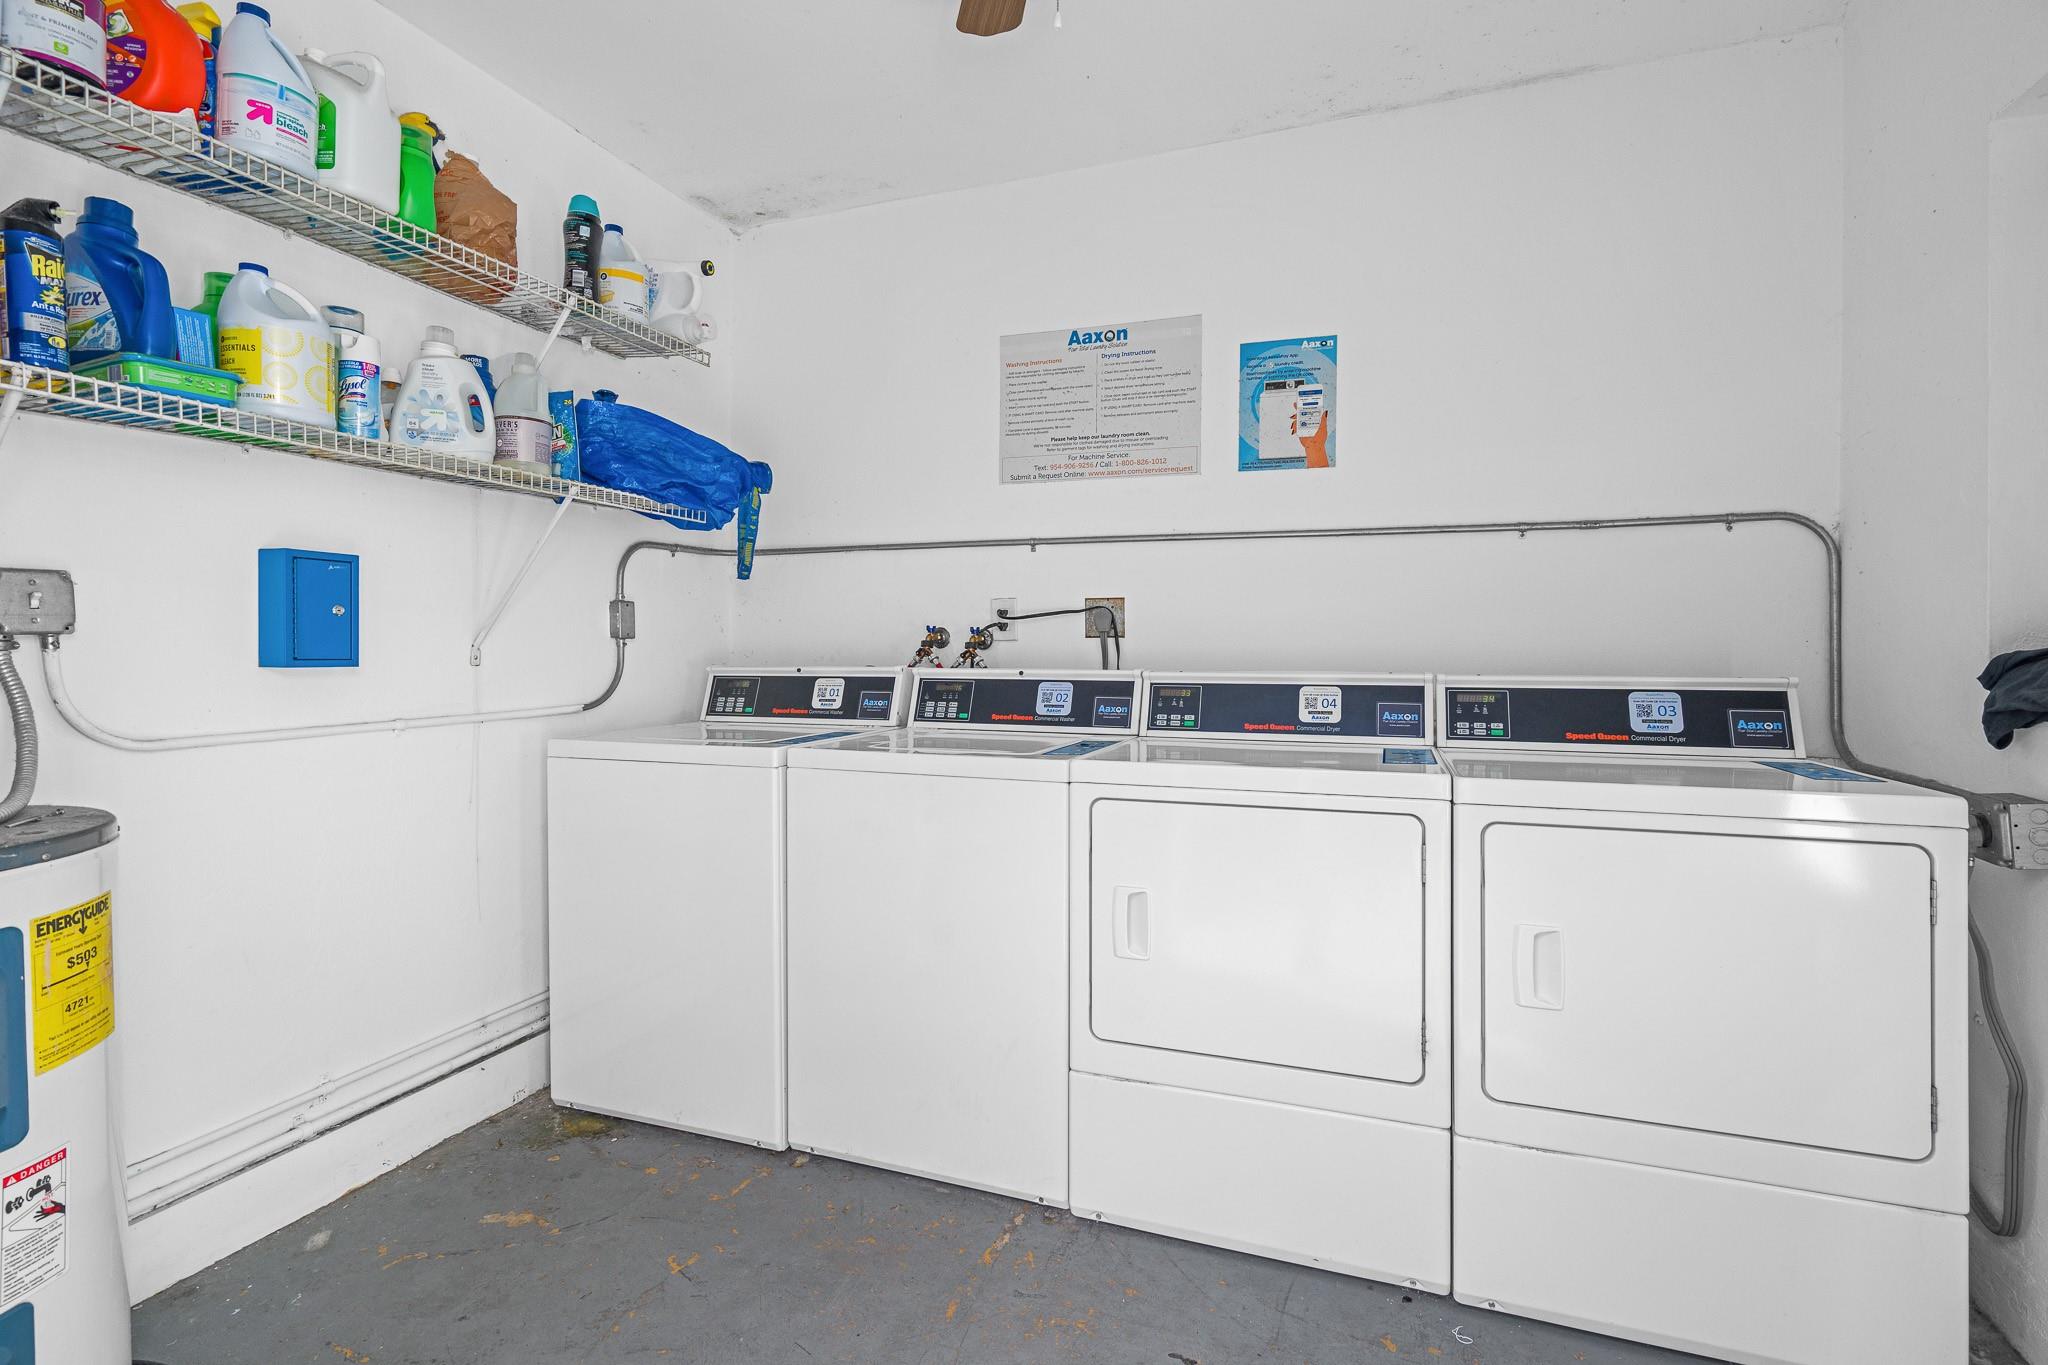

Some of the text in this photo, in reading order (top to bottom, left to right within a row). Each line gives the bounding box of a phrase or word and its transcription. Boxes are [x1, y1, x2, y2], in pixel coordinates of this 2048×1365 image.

[276, 117, 309, 139] bleach
[66, 291, 103, 306] urex
[31, 300, 49, 311] Ant
[1067, 328, 1128, 346] Aaxon
[1301, 339, 1334, 349] Aaxon
[1121, 349, 1157, 357] Instructions
[1005, 361, 1029, 369] Washing
[340, 378, 367, 394] Lysol
[1115, 457, 1168, 467] 1-800-826-1012
[1009, 473, 1032, 481] Submit
[1037, 471, 1063, 480] Request
[1063, 470, 1087, 478] Online:
[1087, 465, 1194, 477] www.aaxon.com/servicerequest
[828, 687, 840, 697] 01
[1055, 692, 1069, 703] 02
[862, 698, 888, 706] Aaxon
[1321, 698, 1338, 709] 04
[771, 707, 790, 715] Speed
[1098, 704, 1128, 713] Aaxon
[1657, 705, 1677, 717] 03
[1382, 711, 1419, 721] Aaxon
[1243, 723, 1269, 731] Speed
[1269, 723, 1296, 731] Queen
[1737, 719, 1783, 730] Aaxon
[1565, 732, 1687, 744] Speed Queen Commercial Dryer
[36, 897, 110, 939] ENERGYGUIDE
[66, 946, 98, 970] $503
[64, 995, 90, 1015] 4721
[20, 1151, 65, 1180] DANGER
